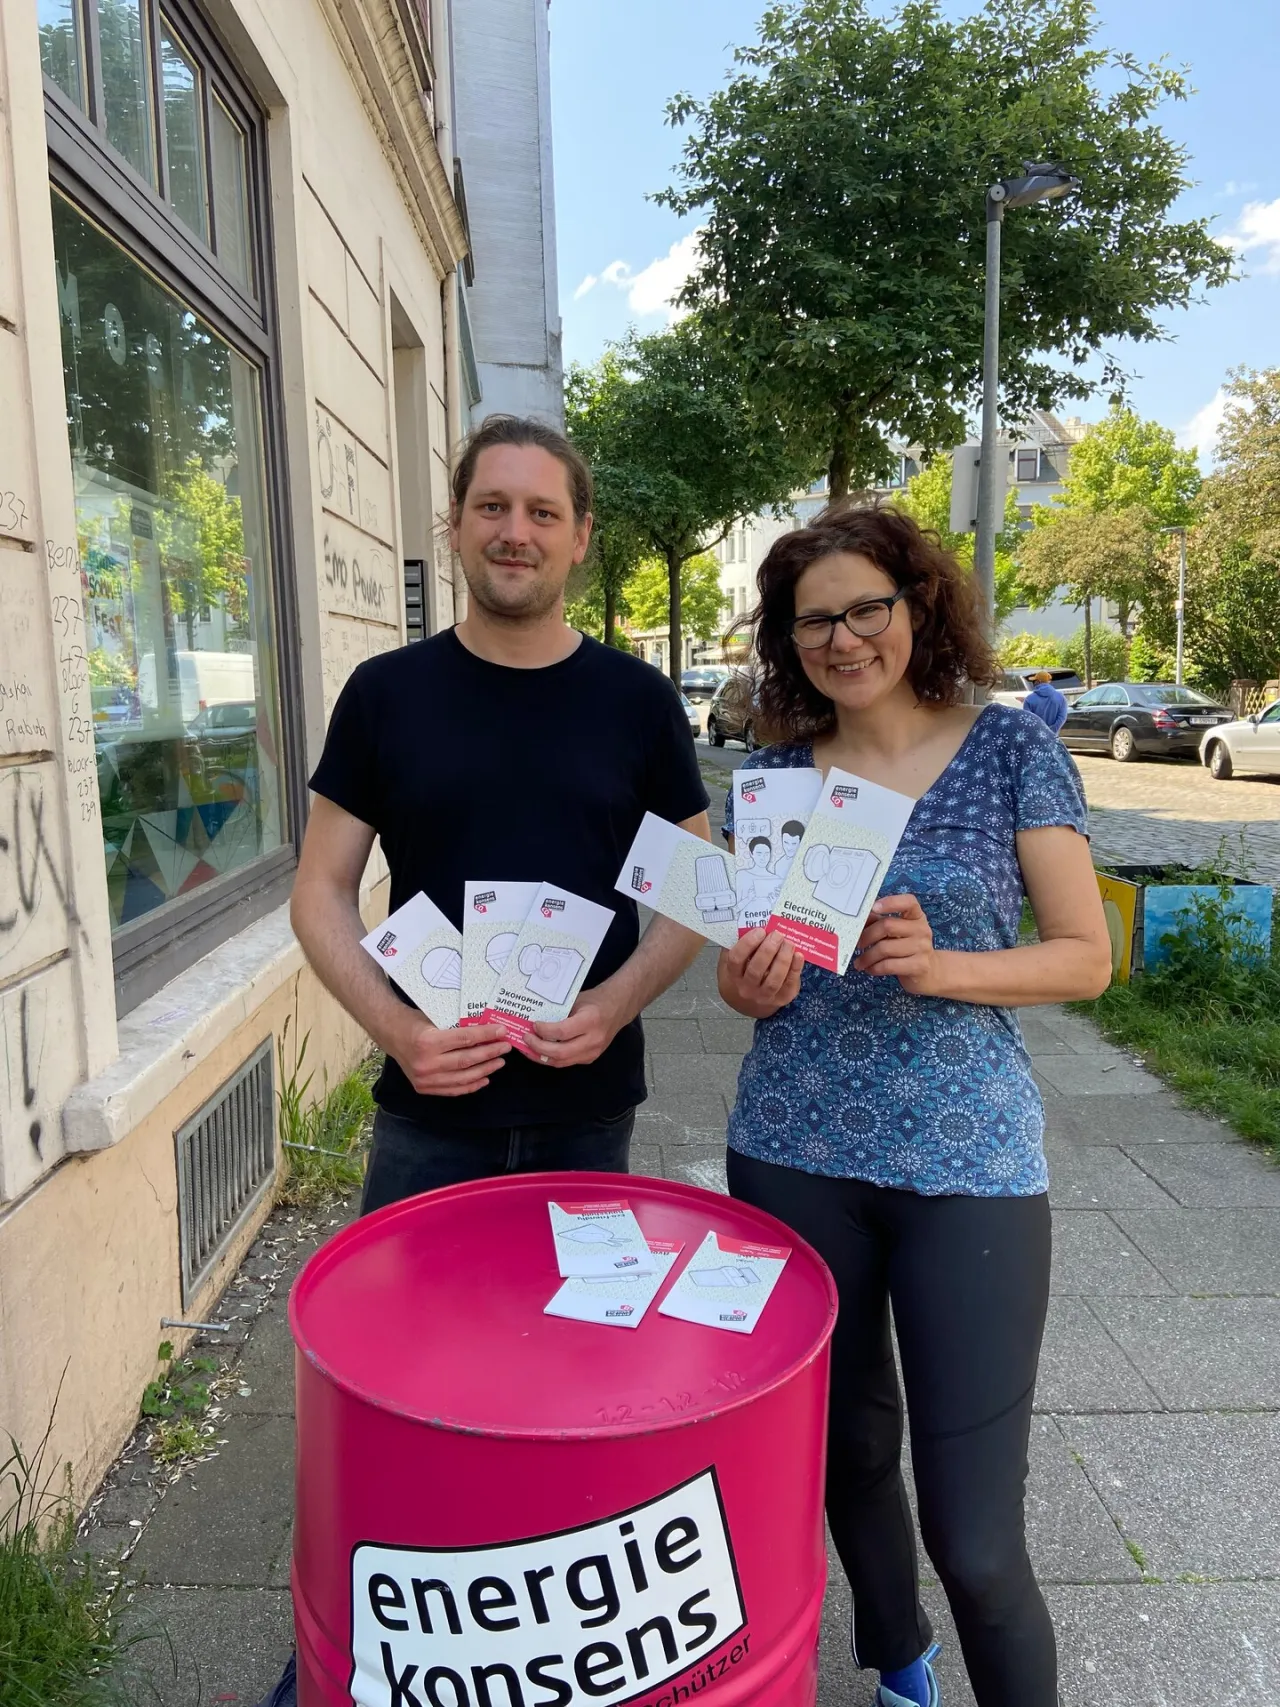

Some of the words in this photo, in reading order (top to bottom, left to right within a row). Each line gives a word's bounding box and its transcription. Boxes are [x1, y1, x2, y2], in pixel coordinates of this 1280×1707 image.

[352, 558, 385, 607] Power
[52, 595, 83, 637] 237
[68, 716, 92, 745] 237
[780, 911, 807, 925] saved
[808, 920, 836, 934] easily
[783, 900, 828, 922] Electricity
[495, 997, 536, 1013] электро-
[499, 988, 544, 1007] Экономия
[493, 1005, 530, 1020] энергии
[368, 1516, 702, 1633] energie
[380, 1588, 718, 1707] konsens
